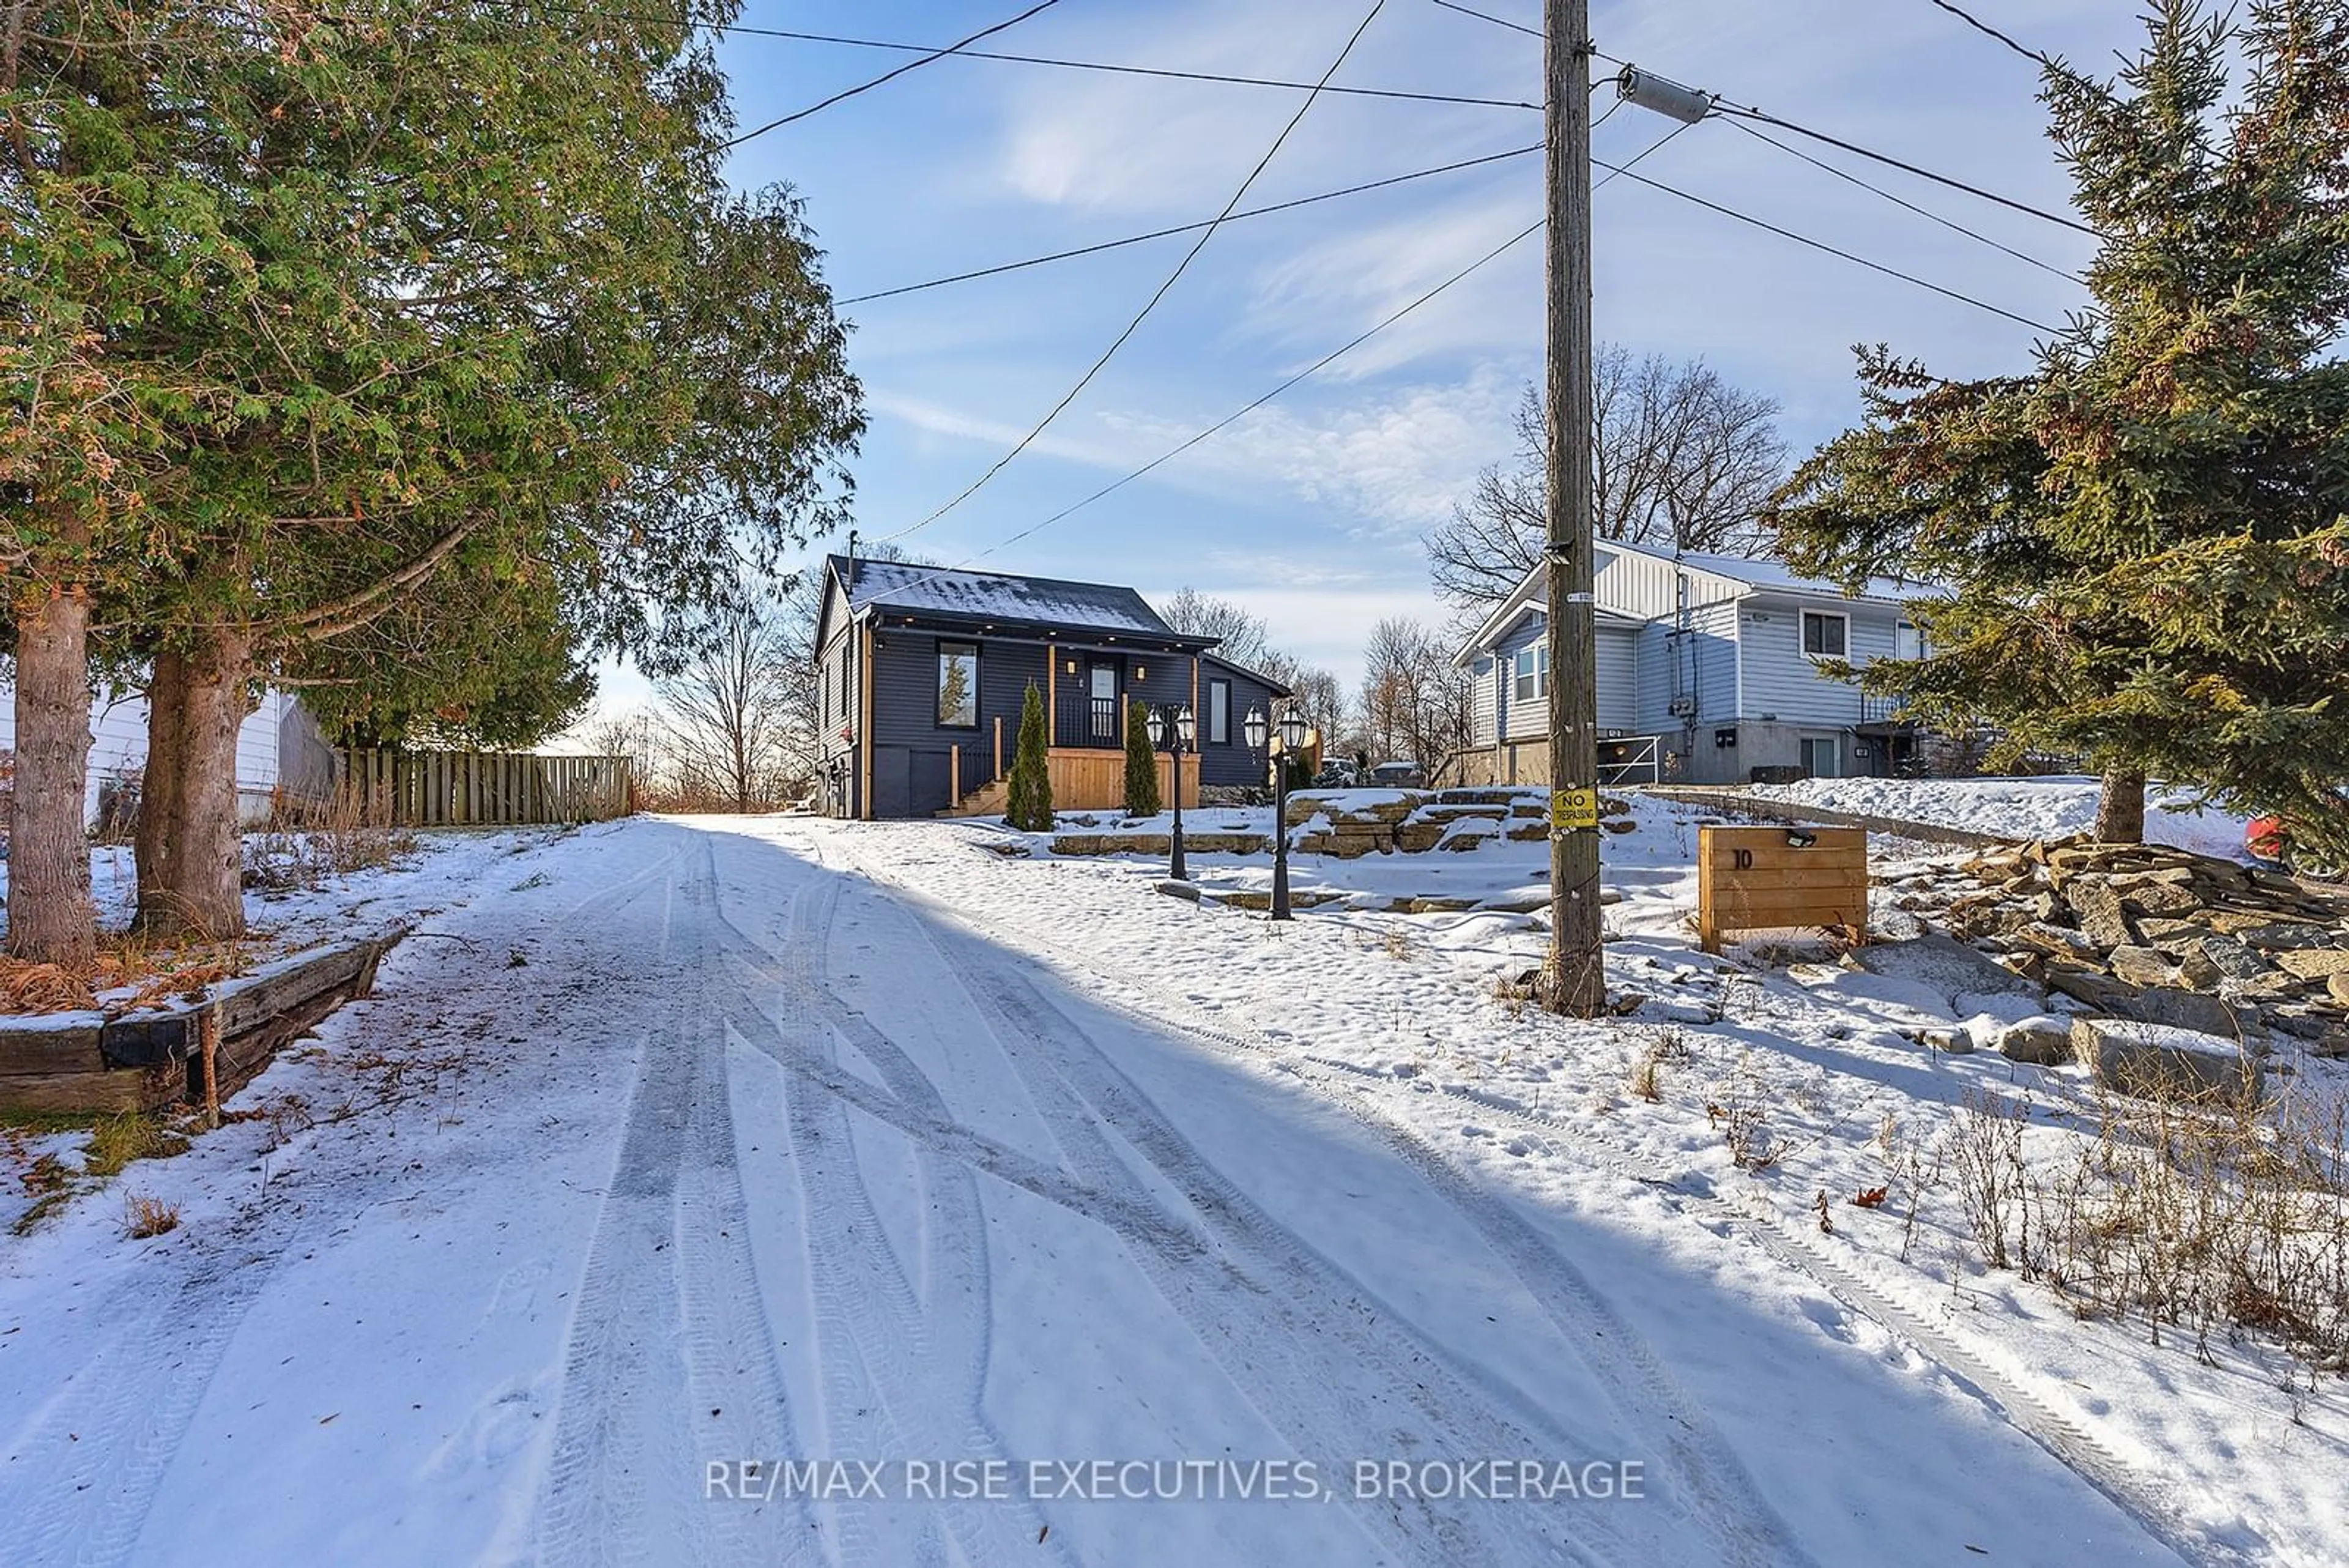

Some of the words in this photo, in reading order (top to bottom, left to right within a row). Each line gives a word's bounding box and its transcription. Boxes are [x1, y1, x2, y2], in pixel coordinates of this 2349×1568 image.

[1563, 795, 1585, 806] NO
[1556, 808, 1594, 820] TRESPASSING
[1733, 849, 1753, 869] 10
